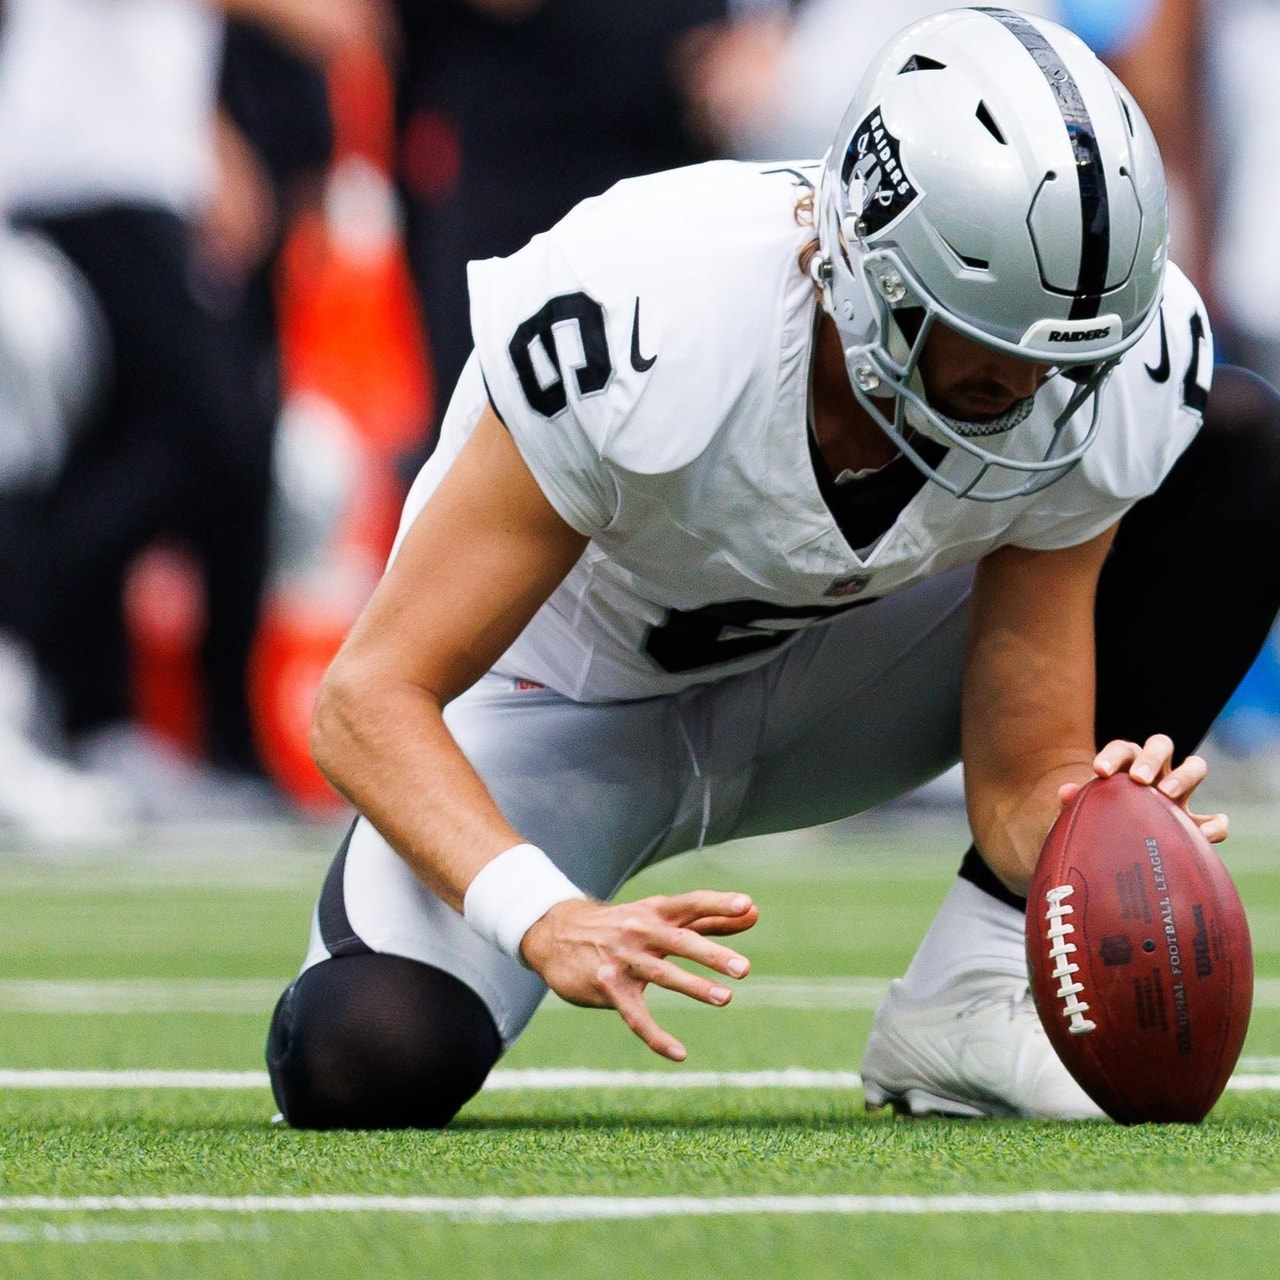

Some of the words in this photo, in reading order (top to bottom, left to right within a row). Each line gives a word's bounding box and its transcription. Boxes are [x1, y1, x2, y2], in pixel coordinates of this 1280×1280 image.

[870, 115, 910, 195] RAIDERS
[1047, 326, 1111, 342] RAIDERS
[1145, 838, 1168, 891] LEAGUE
[1159, 896, 1183, 976] FOOTBALL
[1174, 980, 1191, 1056] IONAL
